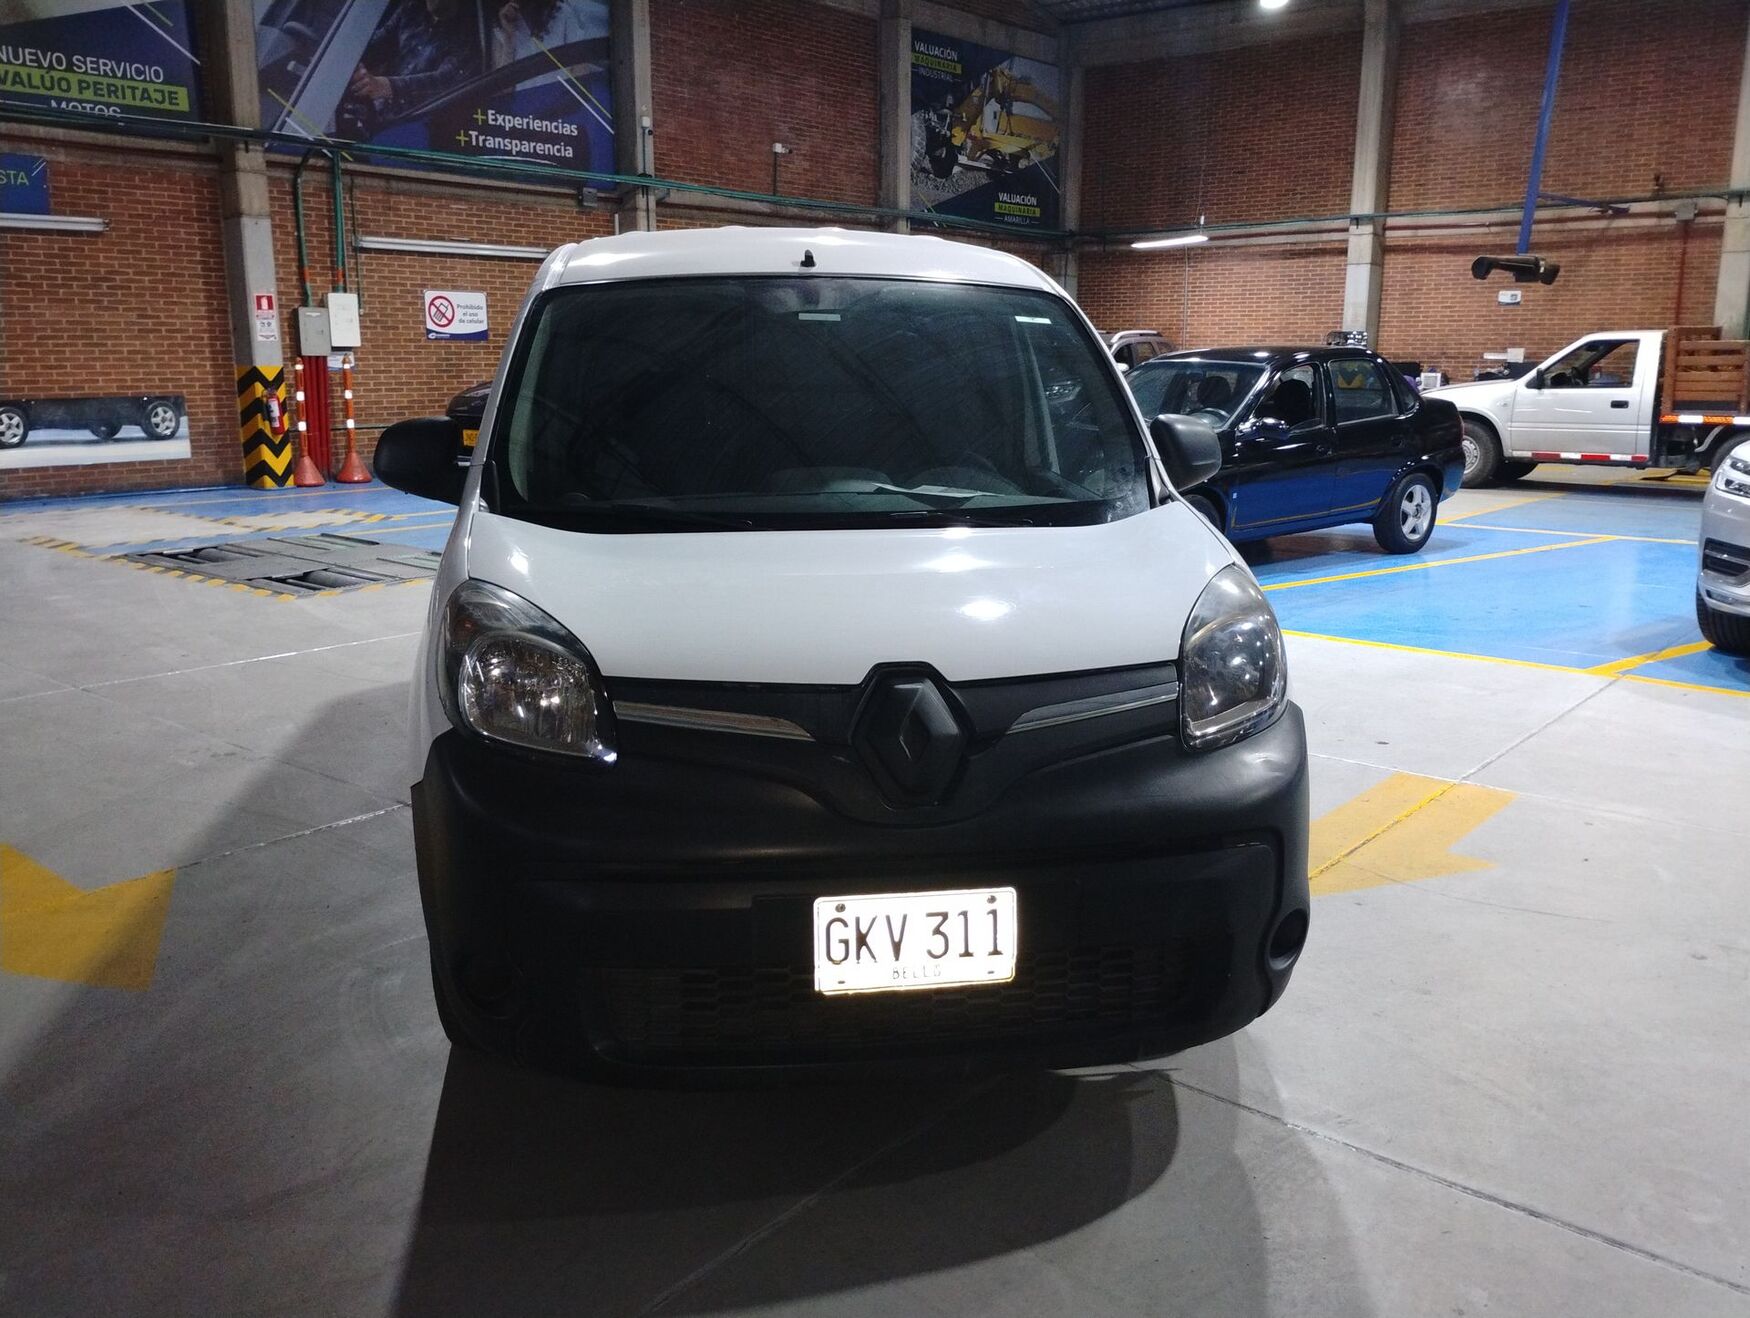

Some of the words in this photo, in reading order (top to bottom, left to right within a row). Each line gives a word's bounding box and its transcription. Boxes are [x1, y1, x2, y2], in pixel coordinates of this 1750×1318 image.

[914, 40, 958, 61] VALUACIÓN
[0, 45, 67, 70] NUEVO
[72, 55, 164, 83] SERVICIO
[77, 79, 180, 106] PERITAJE
[998, 191, 1037, 206] VALUACIÓN
[825, 914, 908, 965] GKV
[925, 908, 1004, 959] 311
[892, 964, 942, 980] BELLO
